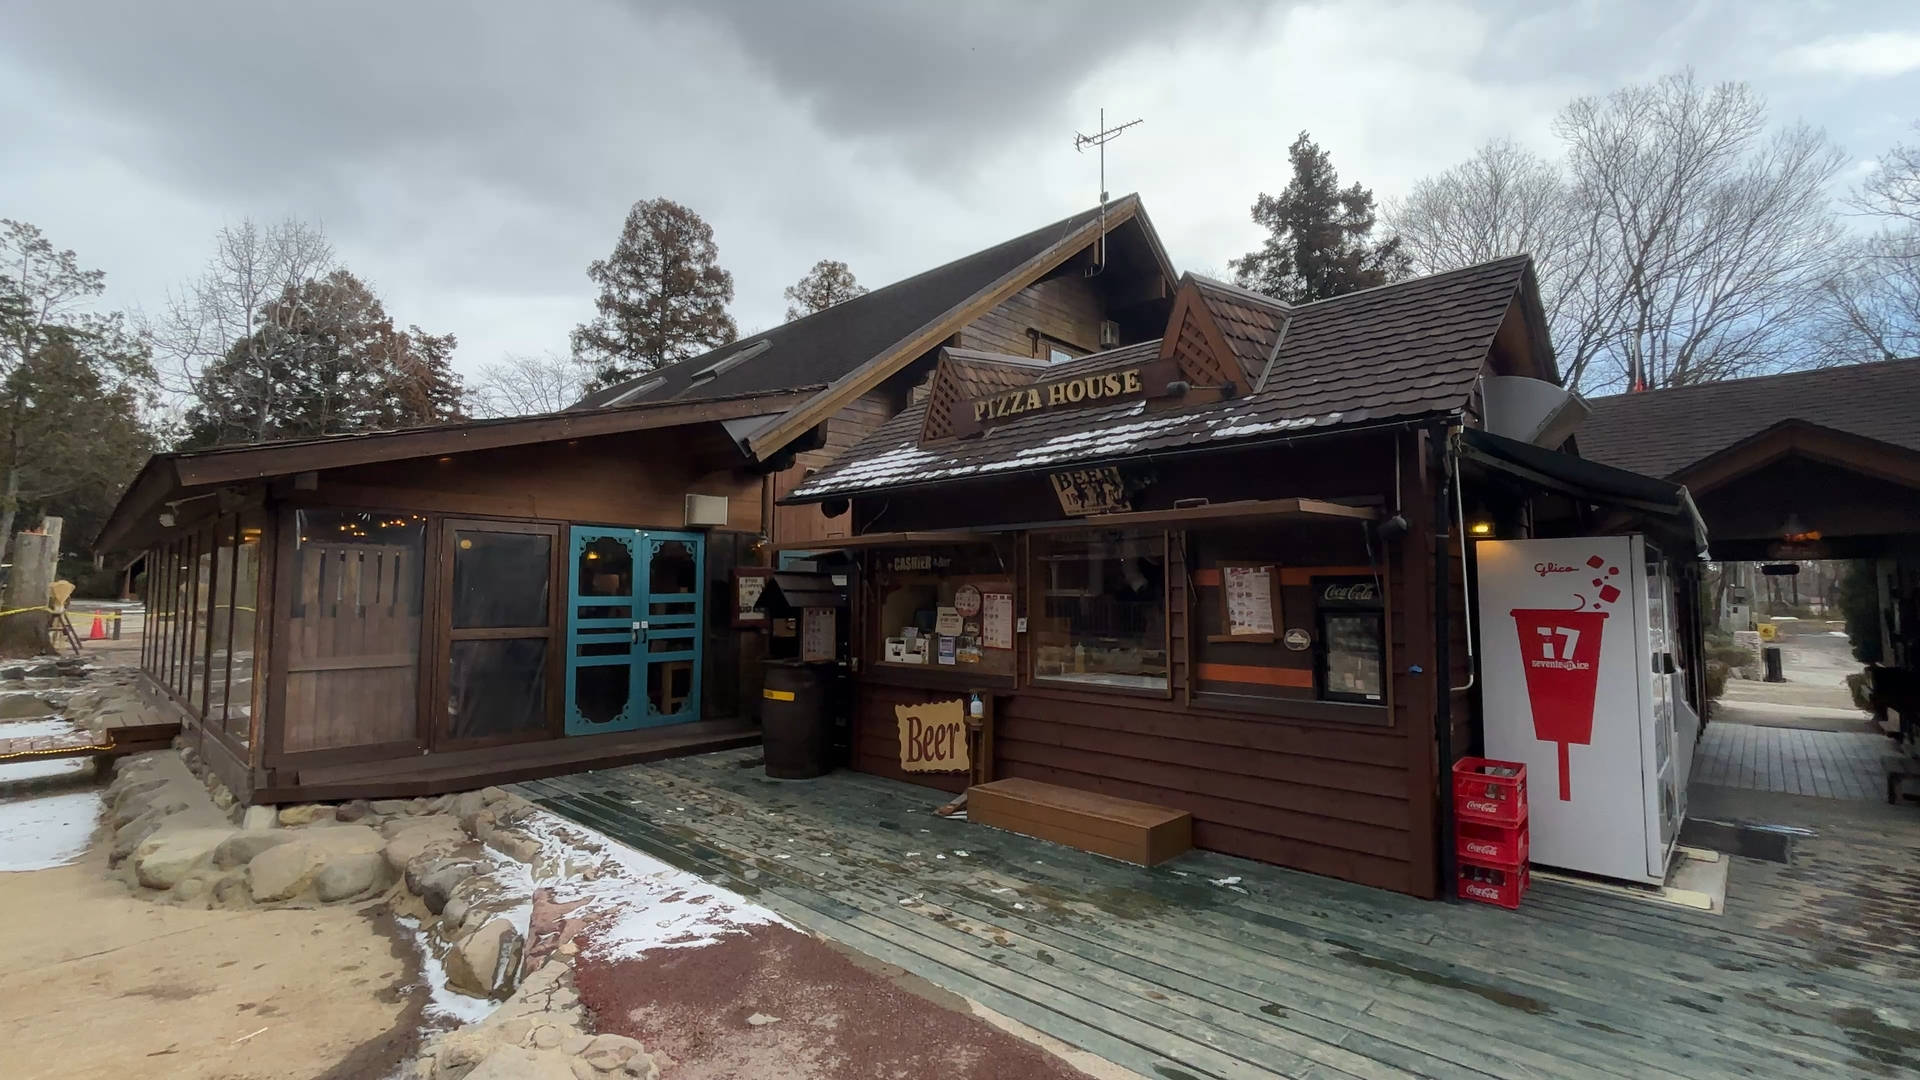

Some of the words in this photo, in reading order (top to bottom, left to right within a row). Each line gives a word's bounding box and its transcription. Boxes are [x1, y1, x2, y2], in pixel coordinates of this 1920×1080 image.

[974, 388, 1042, 422] PIZZA
[1047, 369, 1142, 406] HOUSE
[1056, 467, 1119, 492] BEER
[894, 556, 931, 571] CASHIER
[1534, 562, 1579, 577] Glico
[906, 716, 960, 763] Beer
